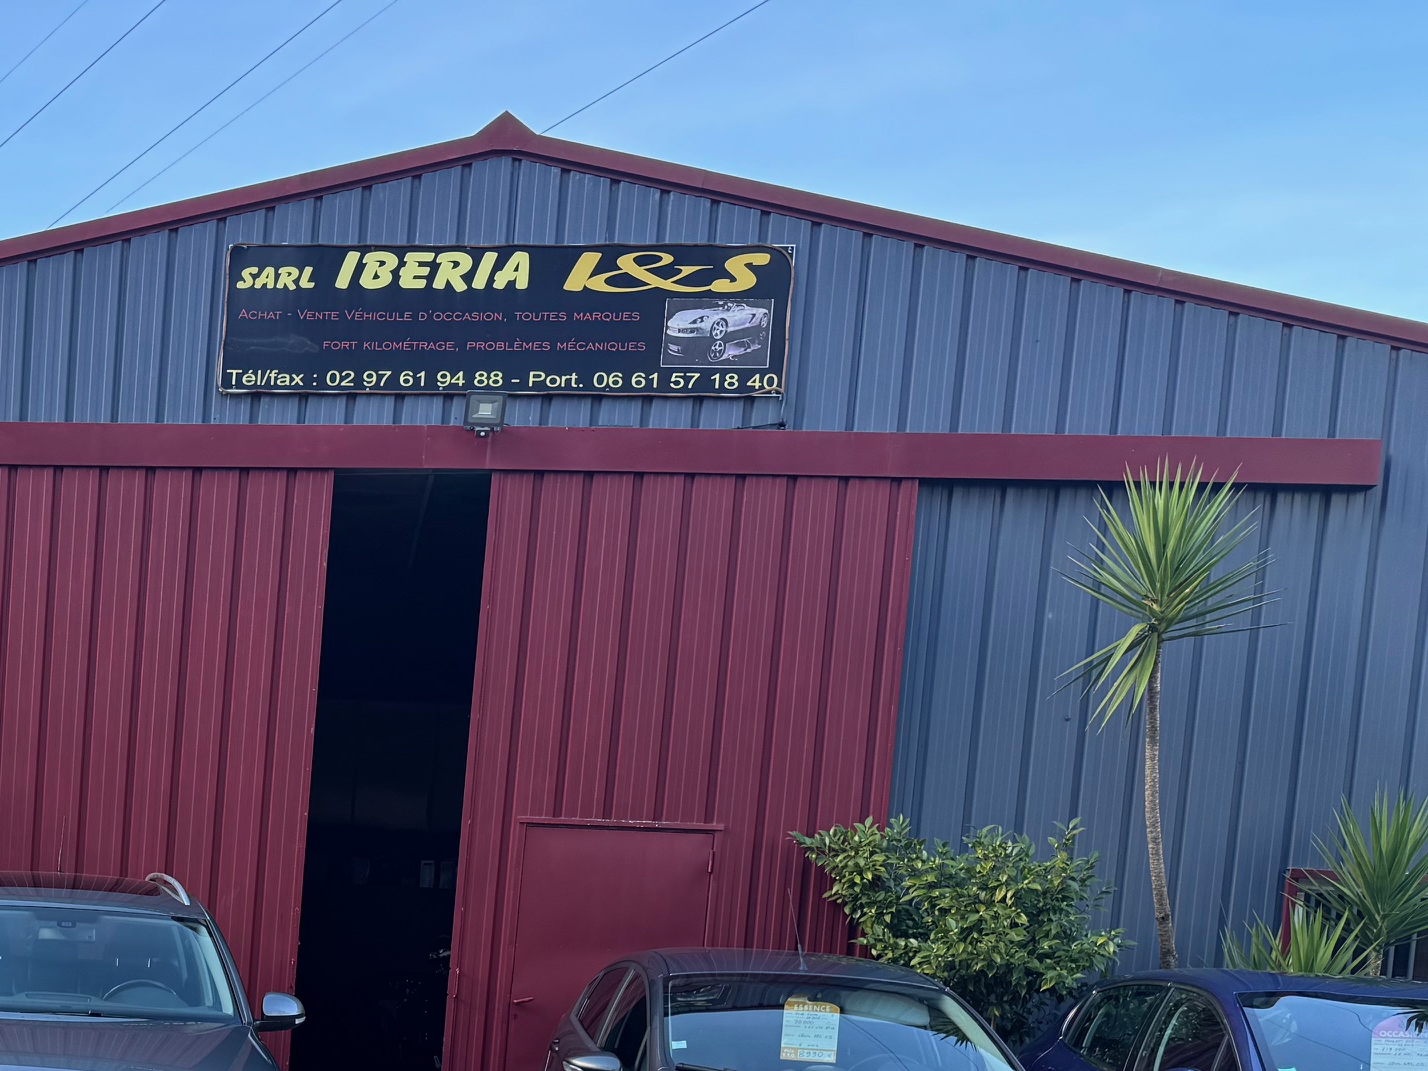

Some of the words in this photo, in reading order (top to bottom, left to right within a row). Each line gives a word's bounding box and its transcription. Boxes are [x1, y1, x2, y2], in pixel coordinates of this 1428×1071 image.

[236, 266, 315, 290] SARL
[335, 250, 530, 292] IBERIA
[563, 251, 771, 292] I&S
[515, 311, 567, 322] TOUTES
[573, 312, 640, 322] MARQUES
[323, 341, 358, 350] FORT
[363, 338, 459, 352] KILOMÉTRAGE,
[467, 338, 551, 351] PROBLÈMES
[557, 338, 646, 351] MÉCANIQUES
[227, 369, 304, 386] Tél/fax
[326, 370, 355, 387] 02
[362, 370, 392, 387] 97
[399, 370, 425, 387] 61
[436, 371, 465, 387] 94
[473, 371, 503, 387] 88
[529, 371, 583, 388] Port.
[593, 372, 622, 388] 06
[631, 372, 658, 388] 61
[670, 373, 700, 389] 57
[711, 373, 739, 389] 18
[746, 373, 778, 390] 40
[793, 1004, 831, 1012] ESSENCE
